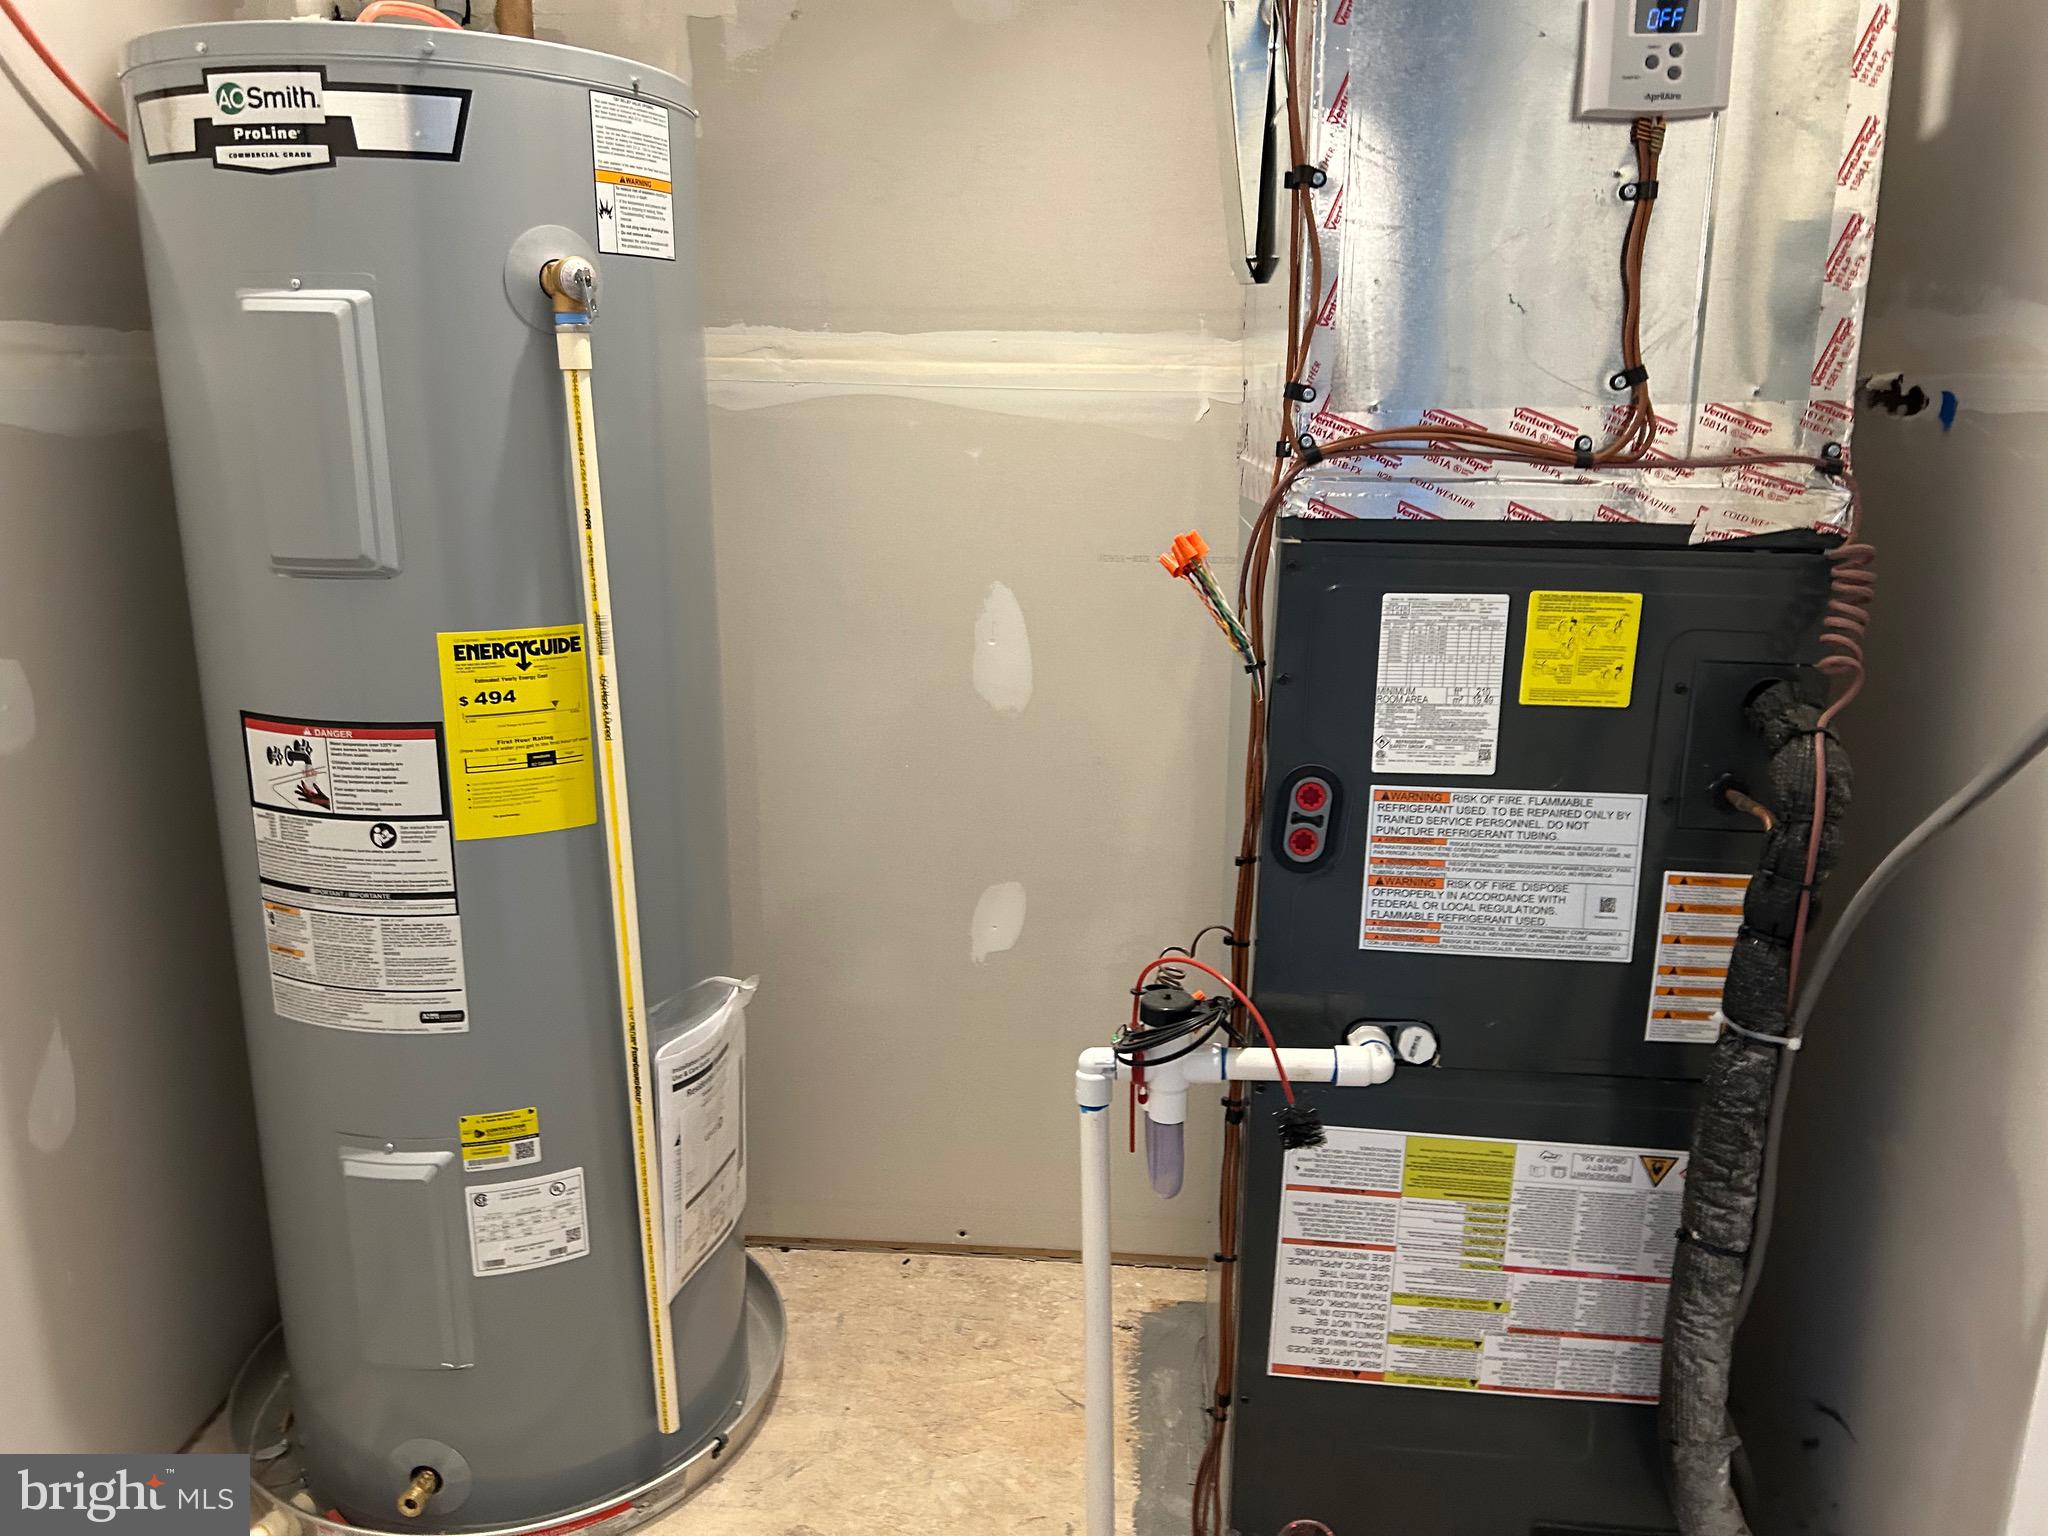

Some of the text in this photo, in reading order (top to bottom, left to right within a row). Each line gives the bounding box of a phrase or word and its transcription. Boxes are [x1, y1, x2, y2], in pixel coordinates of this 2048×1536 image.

[1647, 7, 1685, 29] OFF
[233, 127, 298, 141] ProLine
[1307, 361, 1321, 385] THER
[1514, 408, 1579, 440] VentureTape
[1704, 403, 1772, 436] VentureTape
[1409, 477, 1476, 509] COLD WEATHER
[1637, 492, 1677, 515] WEATHER
[454, 636, 581, 661] ENERGYGUIDE
[459, 690, 516, 706] $ 494
[1377, 695, 1403, 703] ROOM
[314, 729, 353, 738] DANGER
[1391, 792, 1442, 800] WARNING
[1453, 794, 1477, 803] RISK
[1481, 796, 1495, 804] OF
[1528, 797, 1593, 807] FLAMMABLE
[1377, 803, 1453, 814] REFRIGERANT
[1493, 807, 1507, 816] TO
[1510, 808, 1524, 816] BE
[1527, 808, 1582, 818] REPAIRED
[1585, 810, 1615, 819] ONLY
[1617, 812, 1631, 820] BY
[1377, 815, 1423, 824] TRAINED
[1426, 816, 1472, 826] SERVICE
[1547, 820, 1563, 829] DO
[1566, 821, 1590, 830] NOT
[1376, 826, 1435, 836] PUNCTURE
[1437, 828, 1514, 838] REFRIGERANT
[1384, 878, 1436, 887] WARNING
[1446, 881, 1471, 889] RISK
[1474, 881, 1489, 889] OF
[1521, 883, 1569, 893] DISPOSE
[1372, 888, 1444, 899] OFPROPERLY
[1461, 892, 1535, 903] ACCORDANCE
[1538, 895, 1566, 904] WITH
[1372, 899, 1419, 909] FEDERAL
[1422, 901, 1438, 910] OR
[1442, 902, 1476, 911] LOCAL
[1371, 910, 1433, 920] FLAMMABLE
[1437, 913, 1513, 924] REFRIGERANT
[1372, 1254, 1392, 1262] SEE
[1344, 1262, 1391, 1272] SPECIFIC
[1319, 1270, 1390, 1282] USE WITH THE
[1285, 1277, 1389, 1292] DEVICES LISTED FOR
[1290, 1297, 1324, 1306] OTHER
[1307, 1288, 1387, 1302] THAN AUXILIARY
[1298, 1307, 1385, 1320] INSTALLED IN THE
[1315, 1318, 1384, 1330] SHALL NOT BE
[1290, 1326, 1384, 1340] IGNITION SOURCES
[1326, 1339, 1347, 1348] MAY
[1350, 1341, 1383, 1349] WHICH
[1287, 1345, 1382, 1359] AUXILIARY DEVICES
[1318, 1357, 1340, 1365] FIRE
[1343, 1358, 1357, 1367] OF
[1358, 1361, 1382, 1369] RISK
